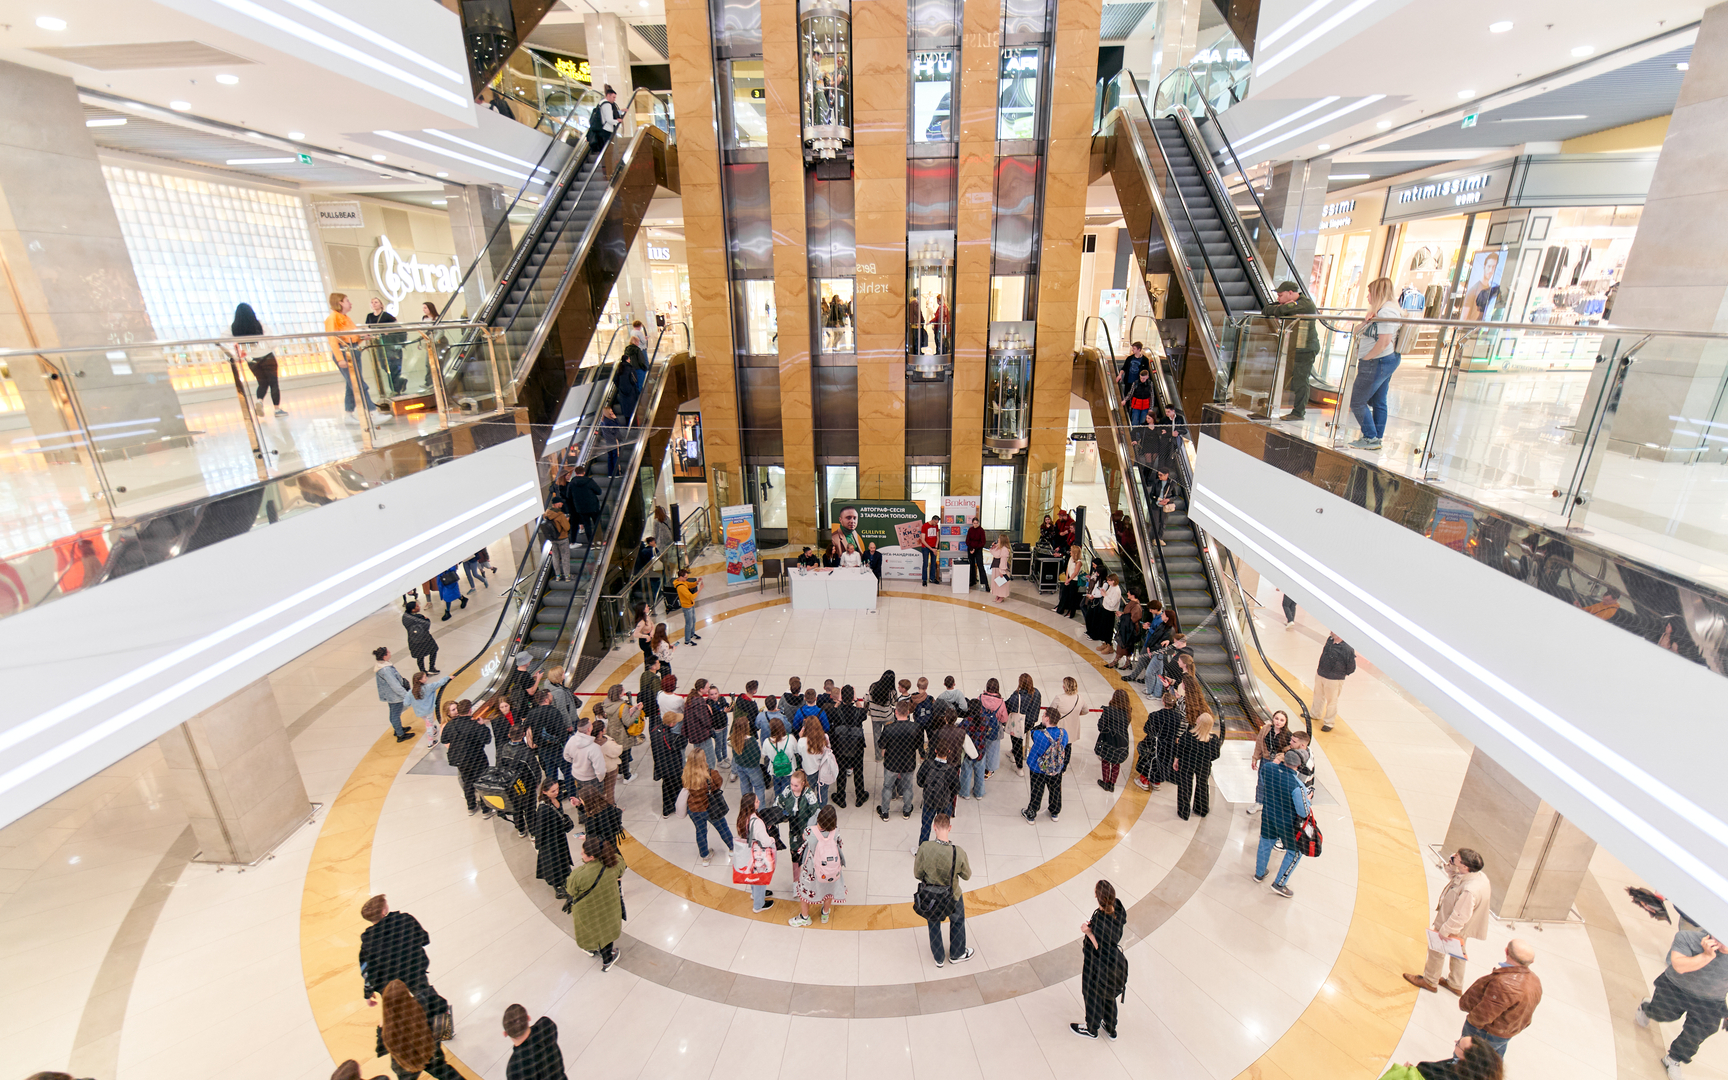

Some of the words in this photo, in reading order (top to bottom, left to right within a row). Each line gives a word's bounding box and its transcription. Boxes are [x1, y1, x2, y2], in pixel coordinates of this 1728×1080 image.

[1399, 174, 1489, 204] intimissimi
[1455, 191, 1481, 206] uomo
[320, 211, 356, 219] PULL&BEAR
